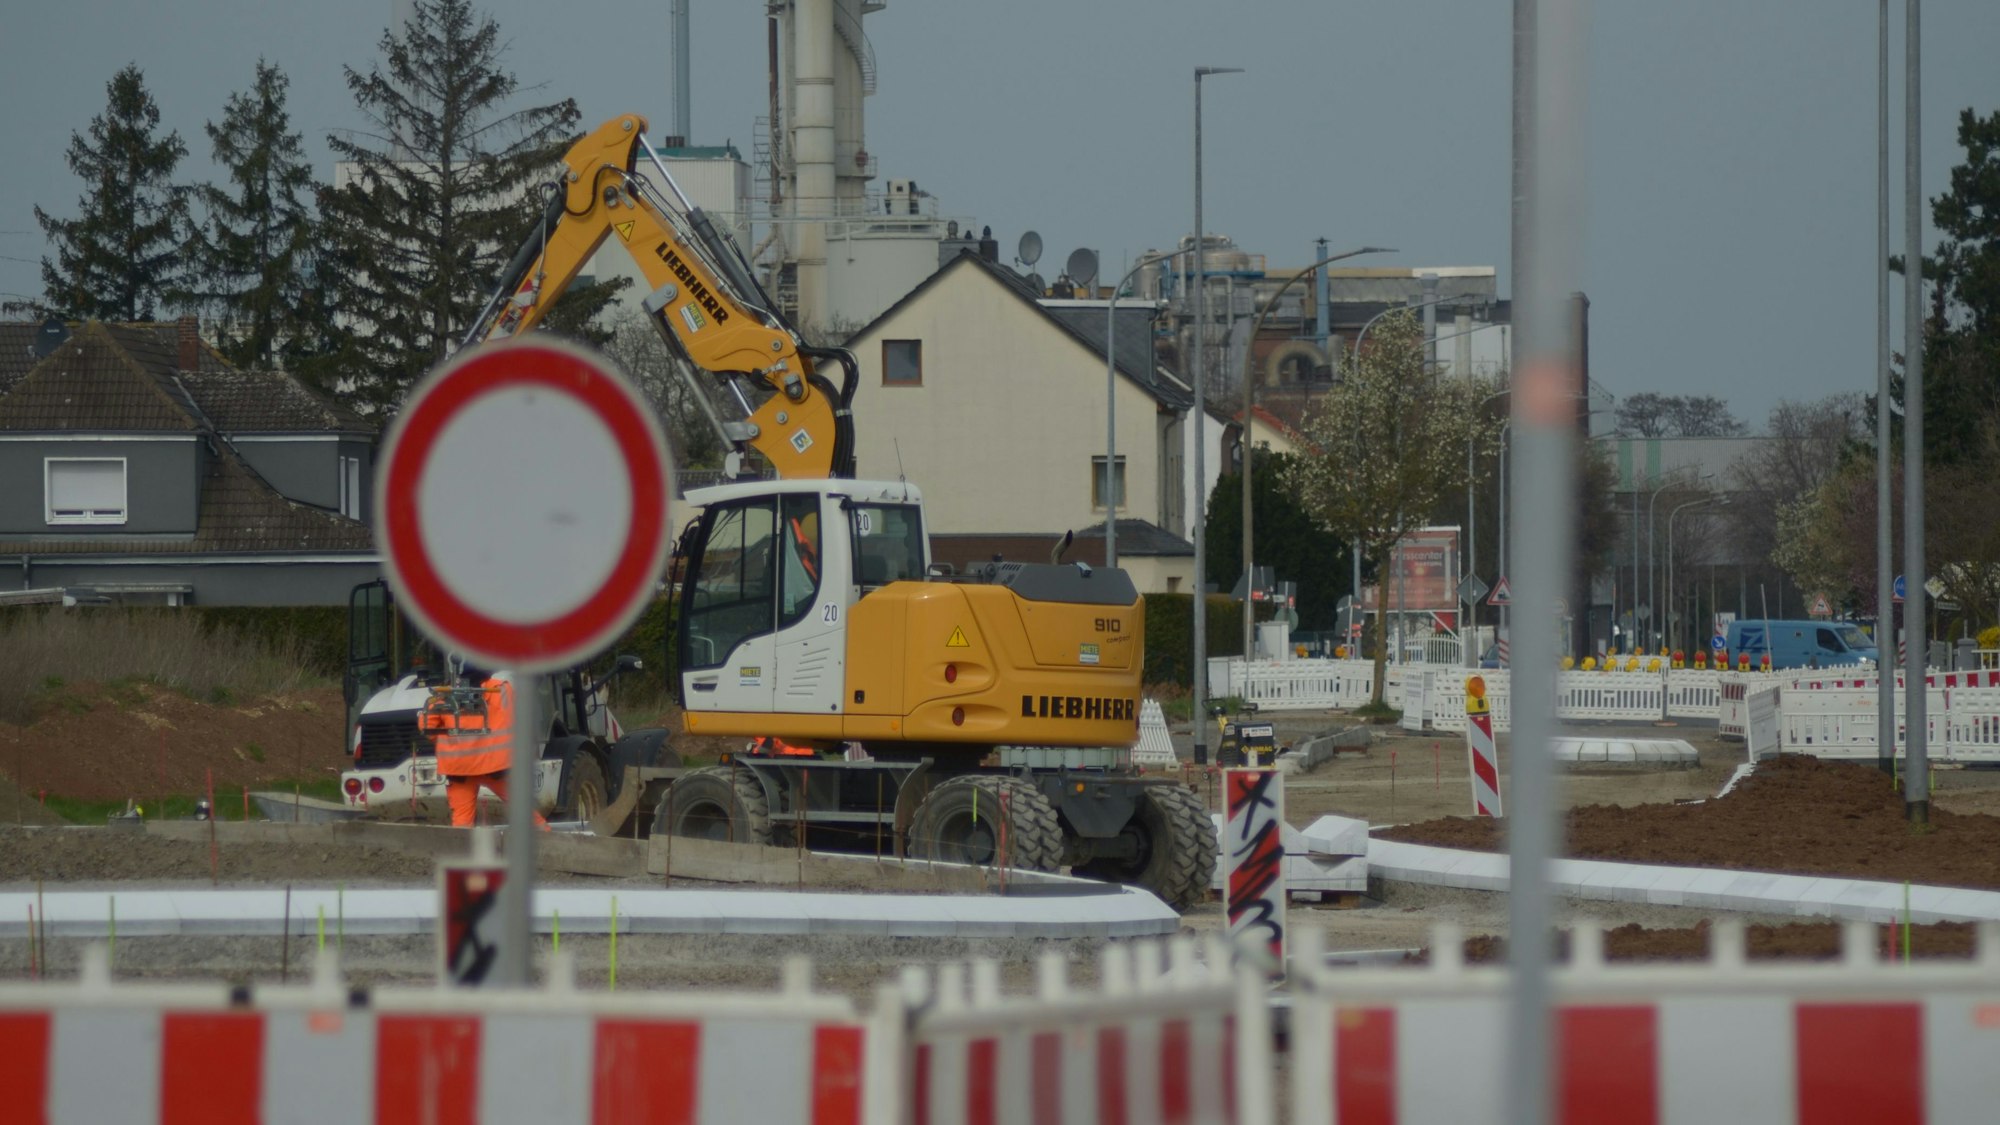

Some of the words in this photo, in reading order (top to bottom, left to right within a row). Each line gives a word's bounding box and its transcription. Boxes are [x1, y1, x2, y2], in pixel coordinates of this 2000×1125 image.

[654, 241, 729, 327] LIEBHERR
[687, 302, 705, 328] MIETE
[823, 604, 838, 622] 20
[1094, 618, 1121, 633] 910
[1080, 644, 1099, 654] MIETE
[740, 668, 761, 677] MIETE
[1021, 695, 1135, 721] LIEBHERR
